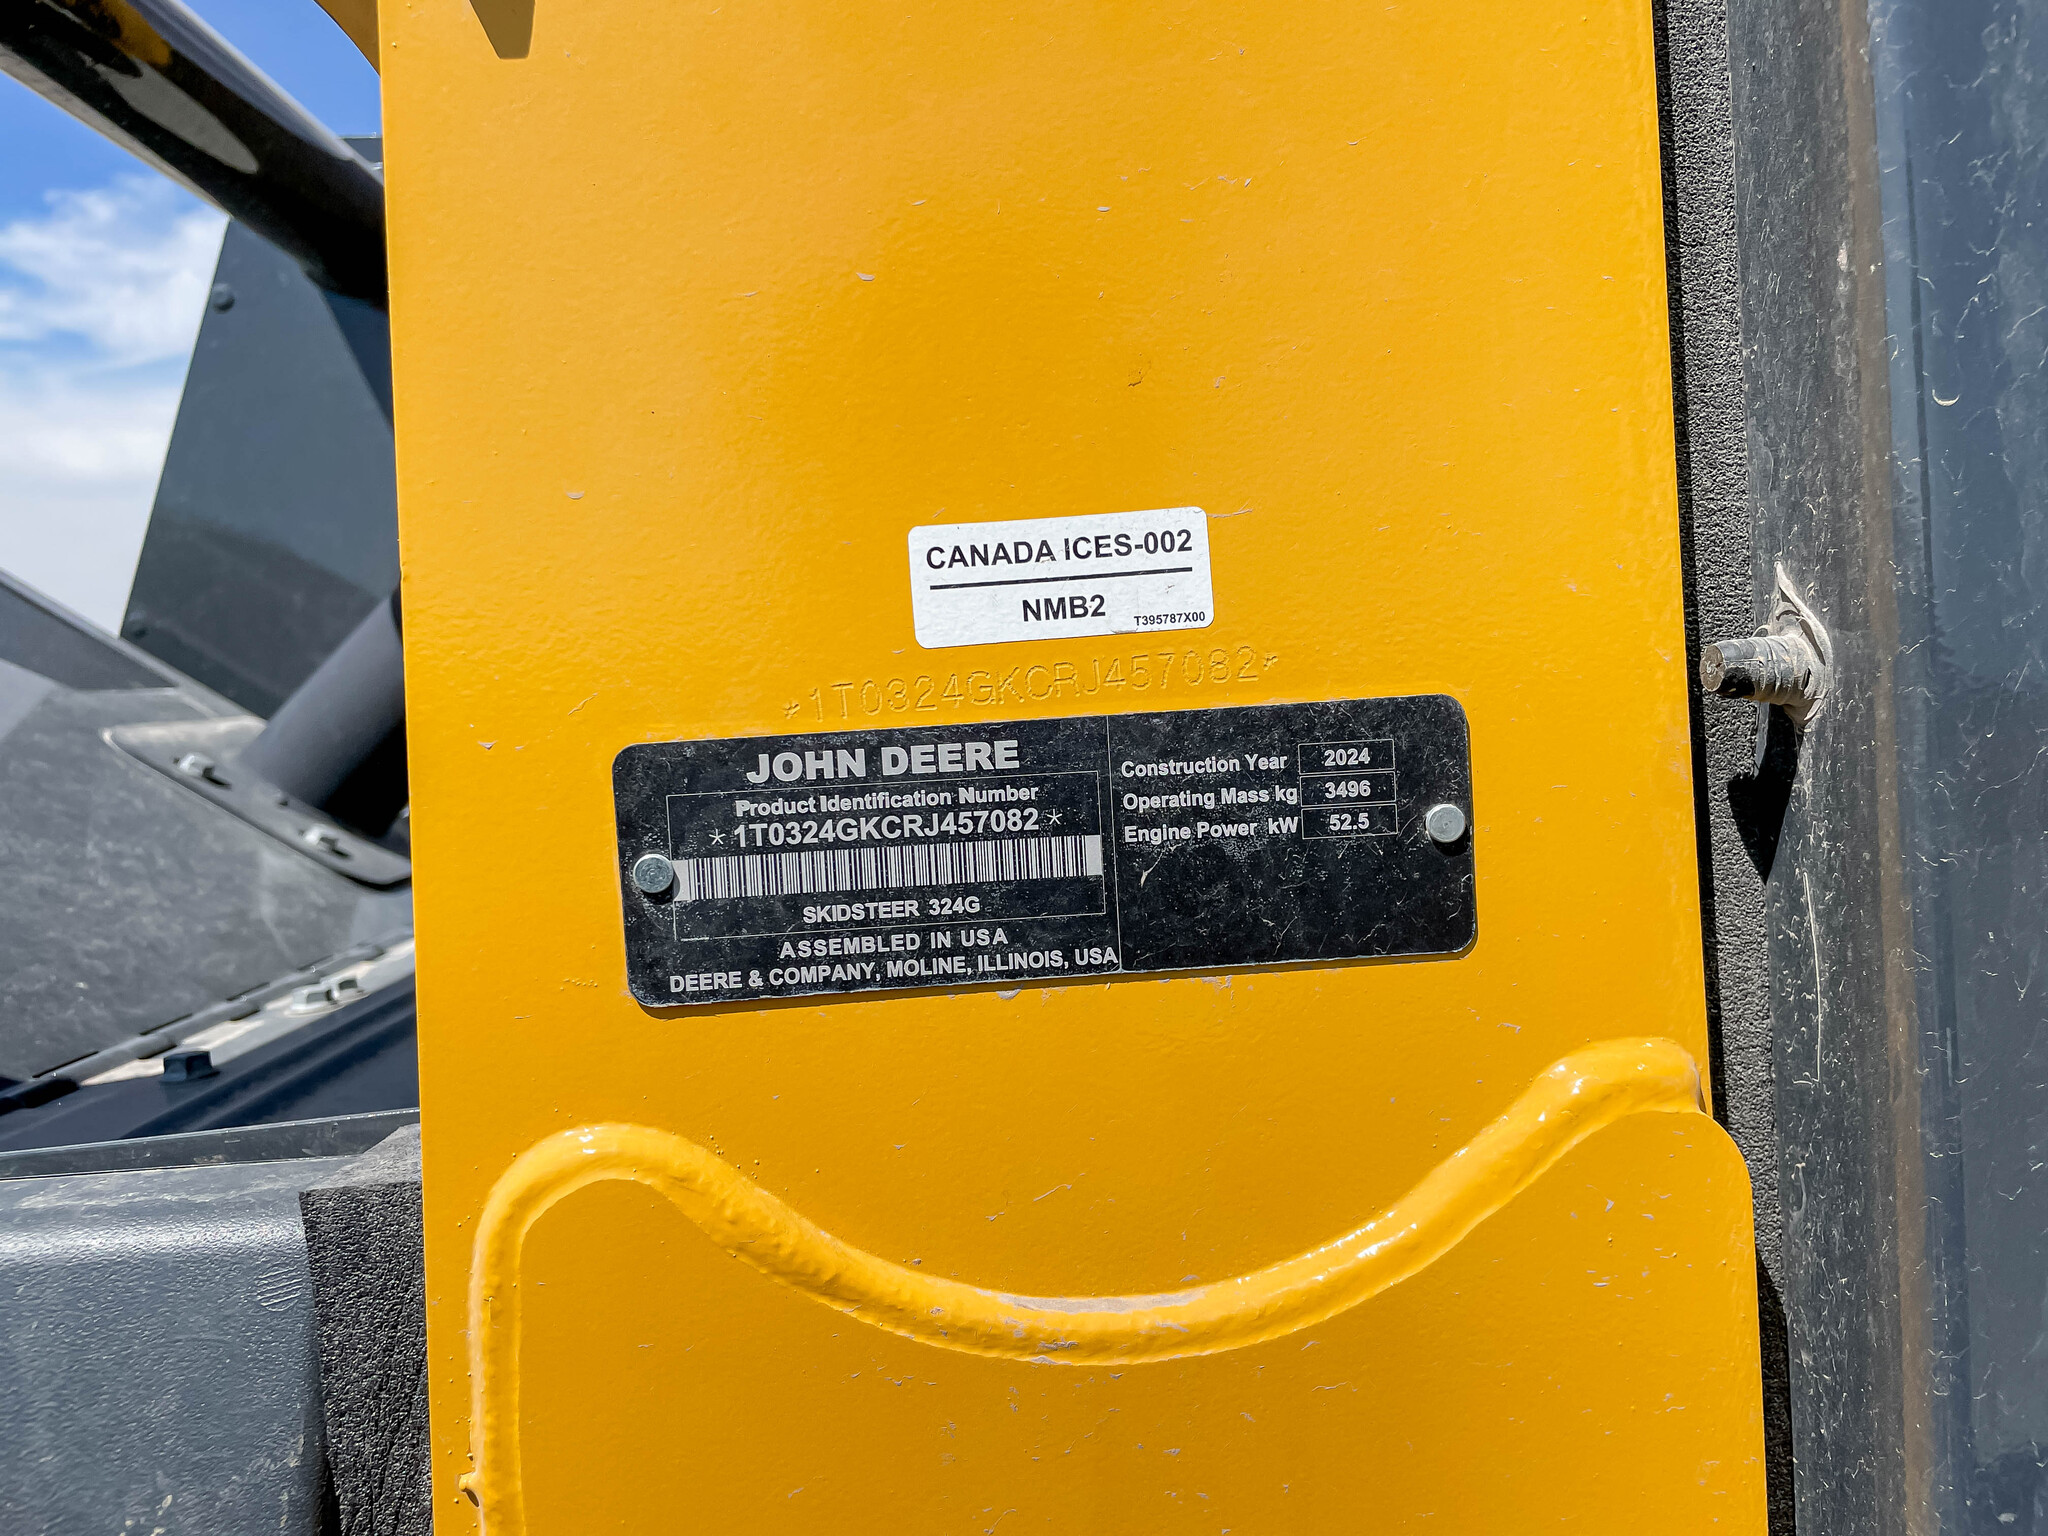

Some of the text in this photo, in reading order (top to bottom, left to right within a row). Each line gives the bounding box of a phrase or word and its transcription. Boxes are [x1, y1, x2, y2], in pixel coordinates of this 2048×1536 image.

[926, 529, 1193, 570] CANADA ICES-002
[1022, 594, 1106, 623] NMB2
[1134, 610, 1206, 627] T395787X00
[746, 739, 1020, 784] JOHN DEERE
[1121, 753, 1288, 778] Construction Year
[1324, 747, 1370, 767] 2024
[735, 783, 1039, 818] Product Identification Number
[1122, 784, 1298, 813] Operating Mass kg
[1324, 779, 1371, 799] 3496
[733, 808, 1040, 848] 1T0324GKCRJ457082
[1124, 816, 1299, 845] Engine Power kW
[1329, 812, 1370, 831] 52.5
[803, 895, 981, 924] SKIDSTEER 324G
[779, 927, 1009, 959] ASSEMBLED IN USA
[669, 946, 1119, 994] DEERE & COMPANY, MOLINE, ILLINOIS, USA
